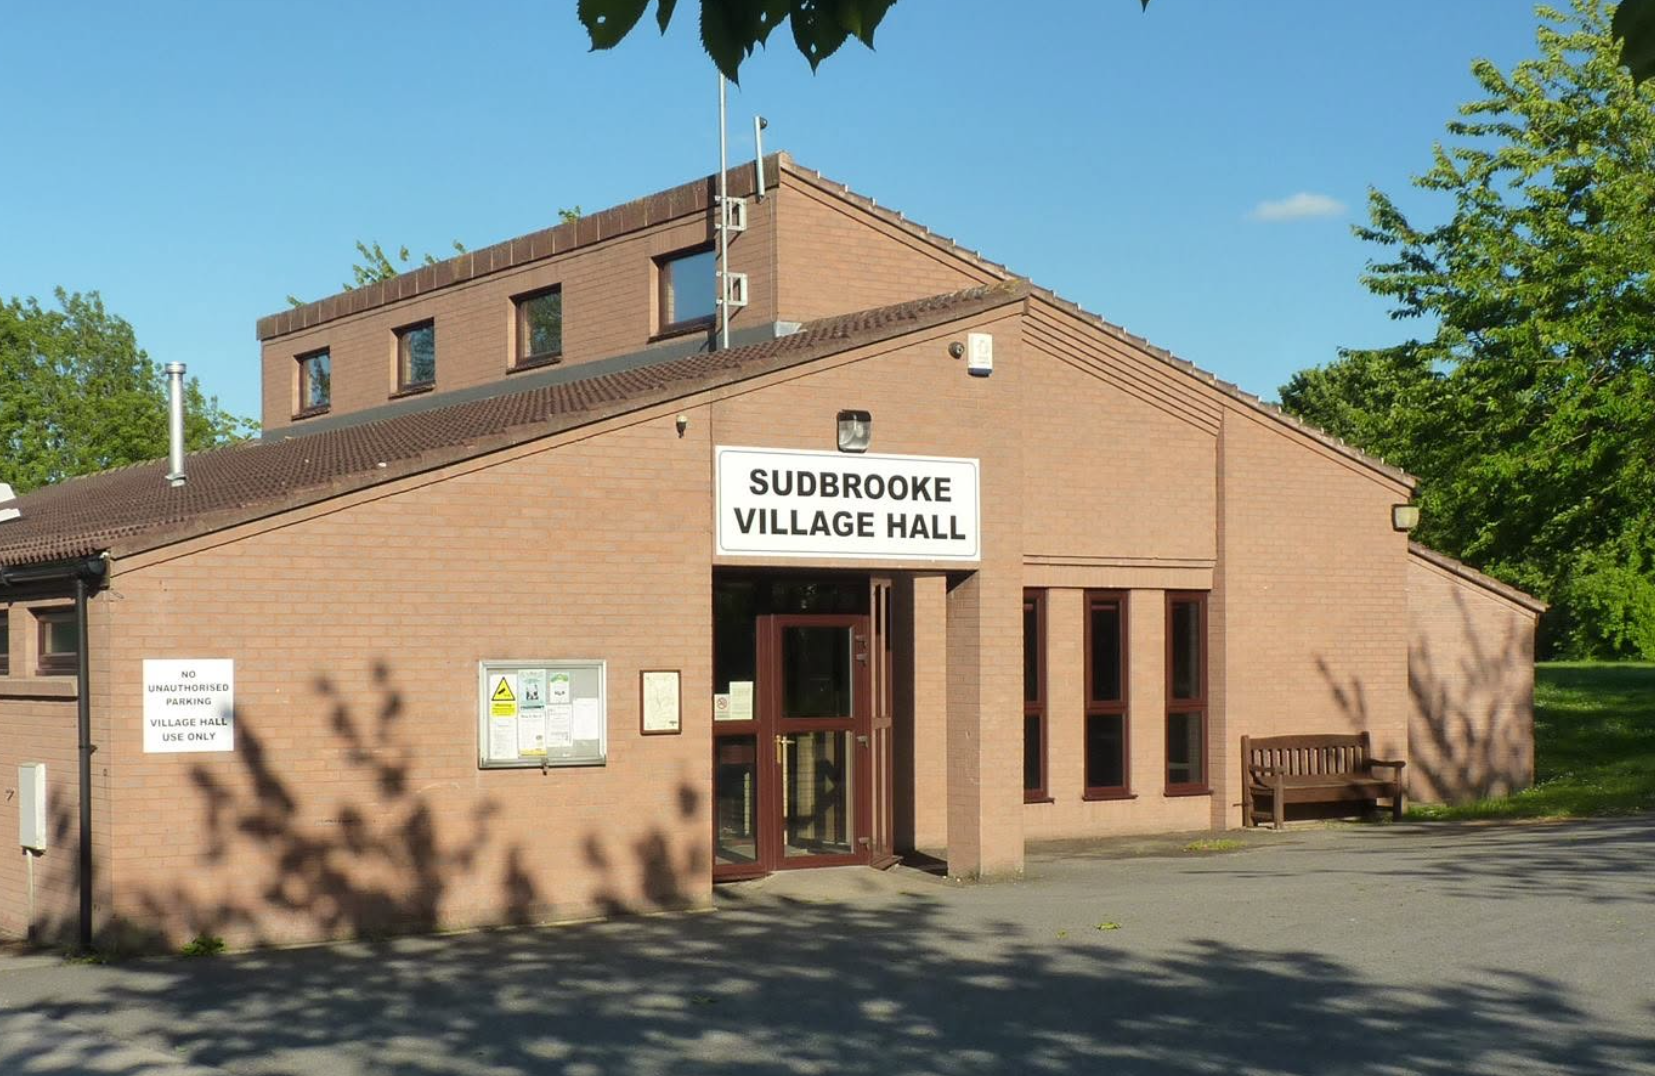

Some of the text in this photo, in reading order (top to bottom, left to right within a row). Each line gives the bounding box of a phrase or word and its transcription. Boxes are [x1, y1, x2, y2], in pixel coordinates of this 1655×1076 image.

[749, 468, 952, 503] SUDBROOKE
[733, 507, 966, 541] VILLAGE HALL
[181, 670, 196, 679] NO
[148, 683, 229, 692] UNAUTHORISED
[166, 697, 212, 706] PARKING
[150, 717, 228, 727] VILLAGE HALL
[162, 732, 216, 742] USE ONLY
